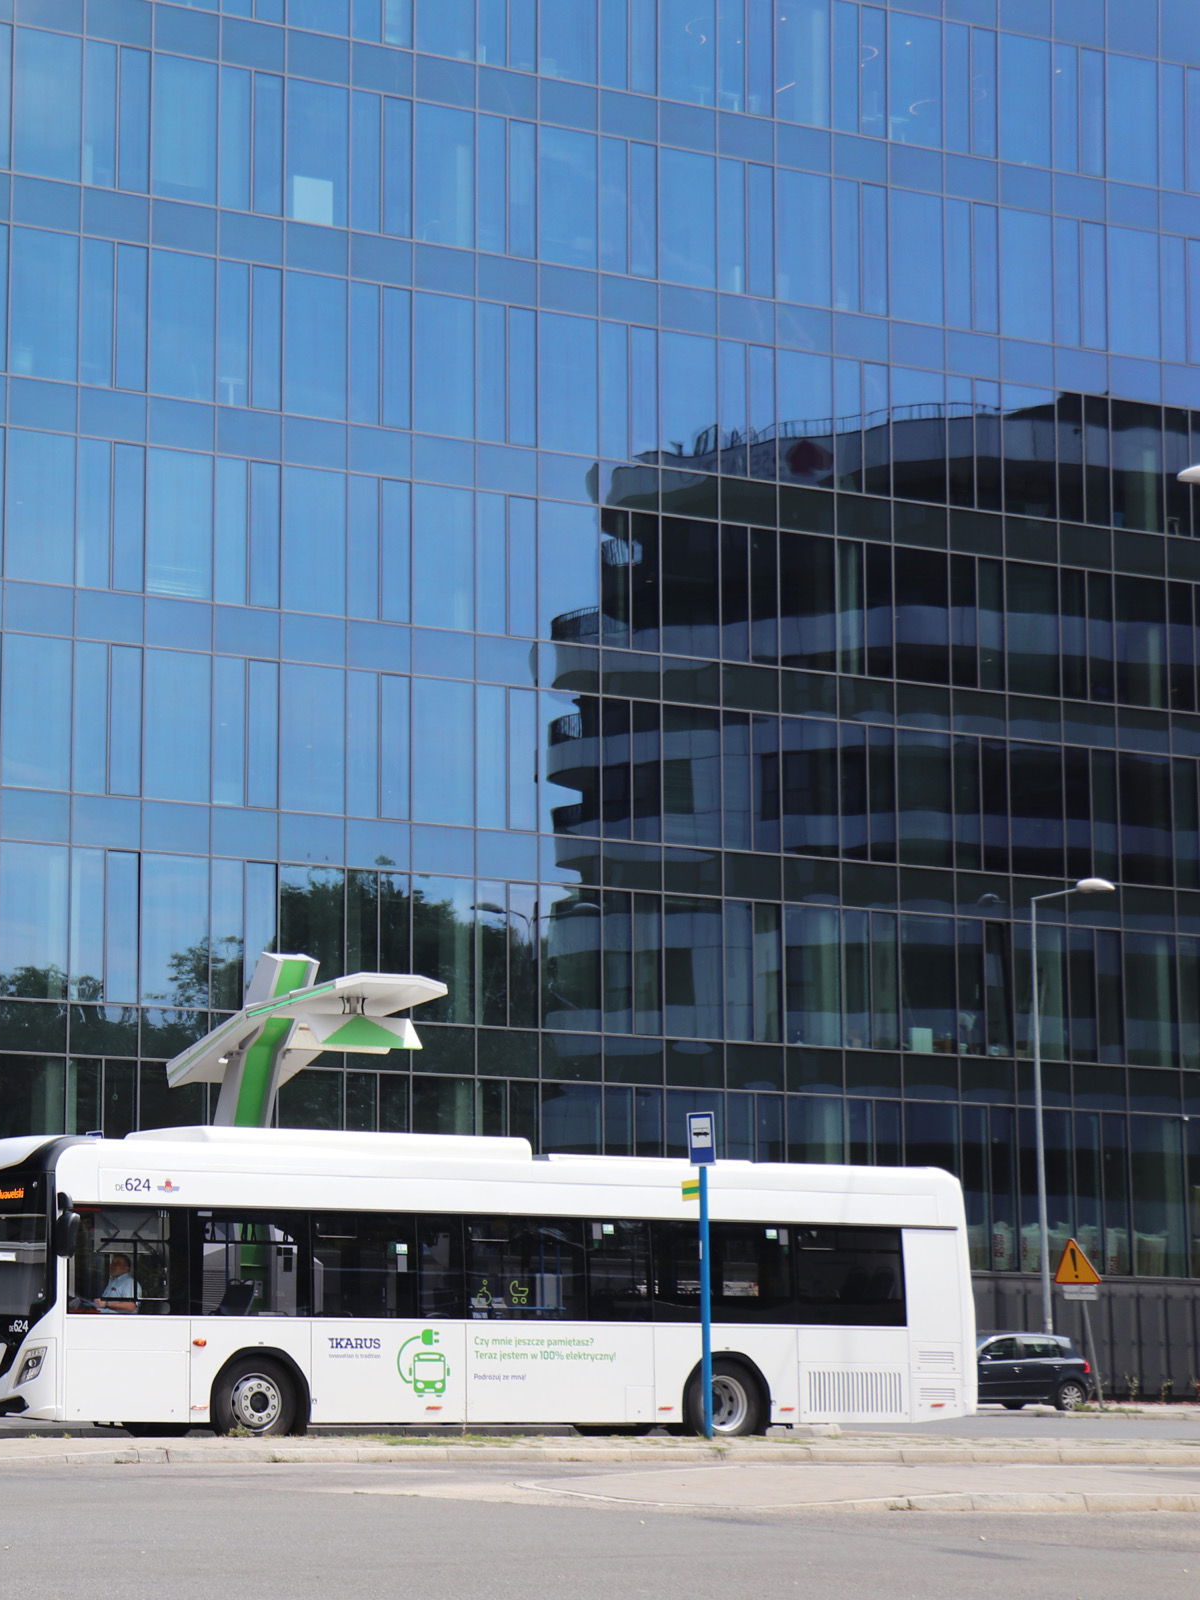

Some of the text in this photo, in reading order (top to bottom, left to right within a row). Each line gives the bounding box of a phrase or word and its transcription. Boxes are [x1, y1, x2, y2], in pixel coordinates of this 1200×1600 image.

[125, 1177, 151, 1192] 624
[14, 1319, 29, 1333] 624
[328, 1337, 381, 1349] IKARUS
[474, 1336, 595, 1348] Czy mnie jeszcze pamiętasz?
[474, 1350, 617, 1362] Teraz jestem w 100% elektryczny!
